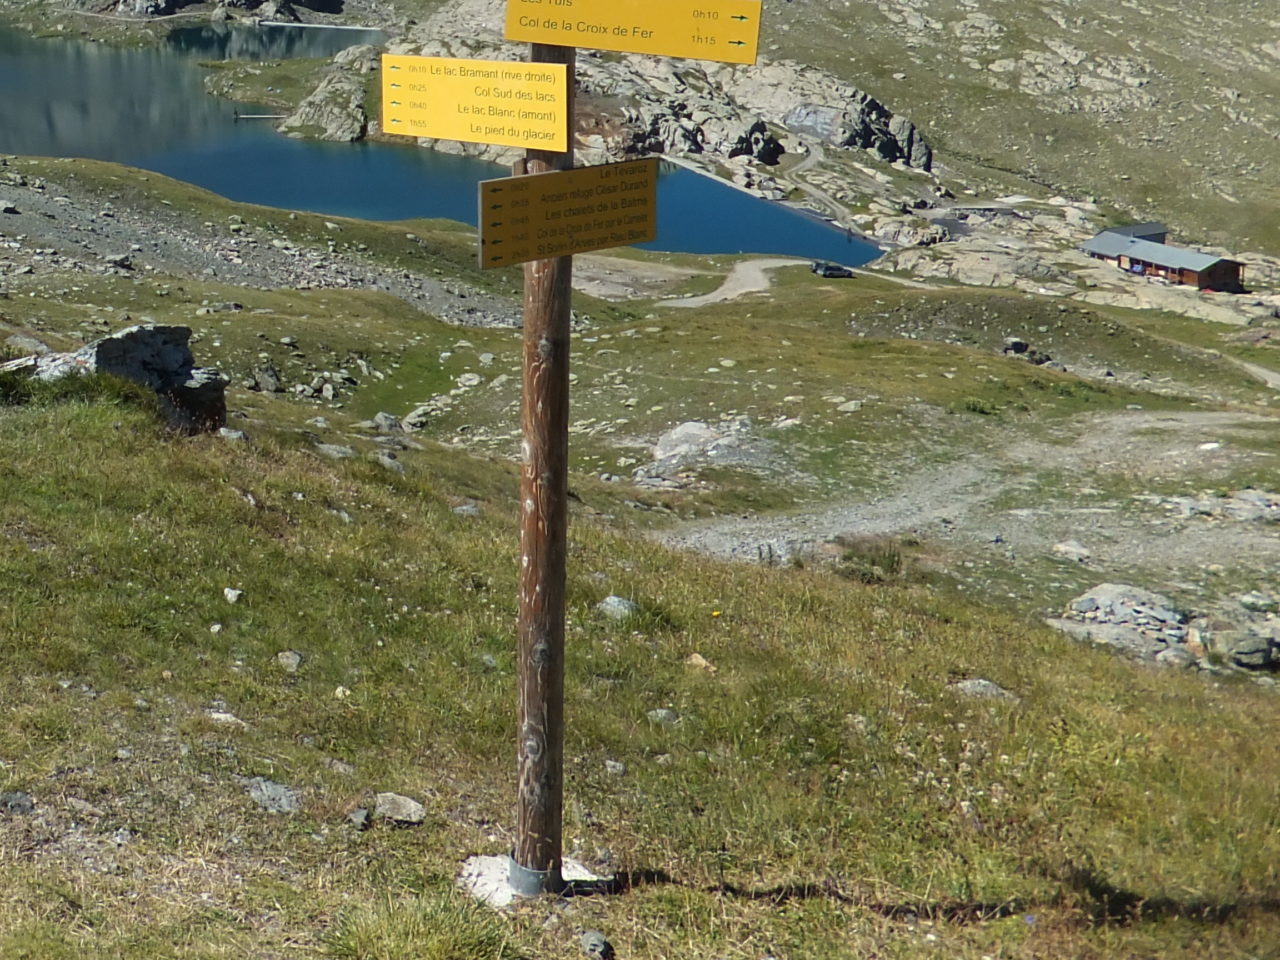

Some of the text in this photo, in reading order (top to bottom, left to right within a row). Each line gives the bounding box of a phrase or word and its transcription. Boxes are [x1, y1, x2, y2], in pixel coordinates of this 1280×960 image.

[692, 9, 719, 20] 0h10
[519, 16, 716, 45] Col de la Croix de Fer 1h15
[430, 65, 441, 75] Le
[444, 66, 457, 75] lac
[459, 67, 498, 79] Bramant
[501, 69, 521, 81] (rive
[524, 71, 556, 84] droite)
[474, 86, 490, 97] Col
[493, 87, 512, 99] Sud
[515, 89, 533, 100] des
[536, 91, 556, 102] lacs
[457, 104, 469, 114] Le
[472, 105, 486, 115] lac
[488, 106, 515, 118] Blanc
[518, 108, 556, 123] (amont)
[470, 123, 482, 134] Le
[485, 124, 505, 137] pied
[507, 126, 520, 137] du
[522, 128, 556, 141] glacier
[545, 209, 561, 221] Les
[597, 201, 608, 212] de
